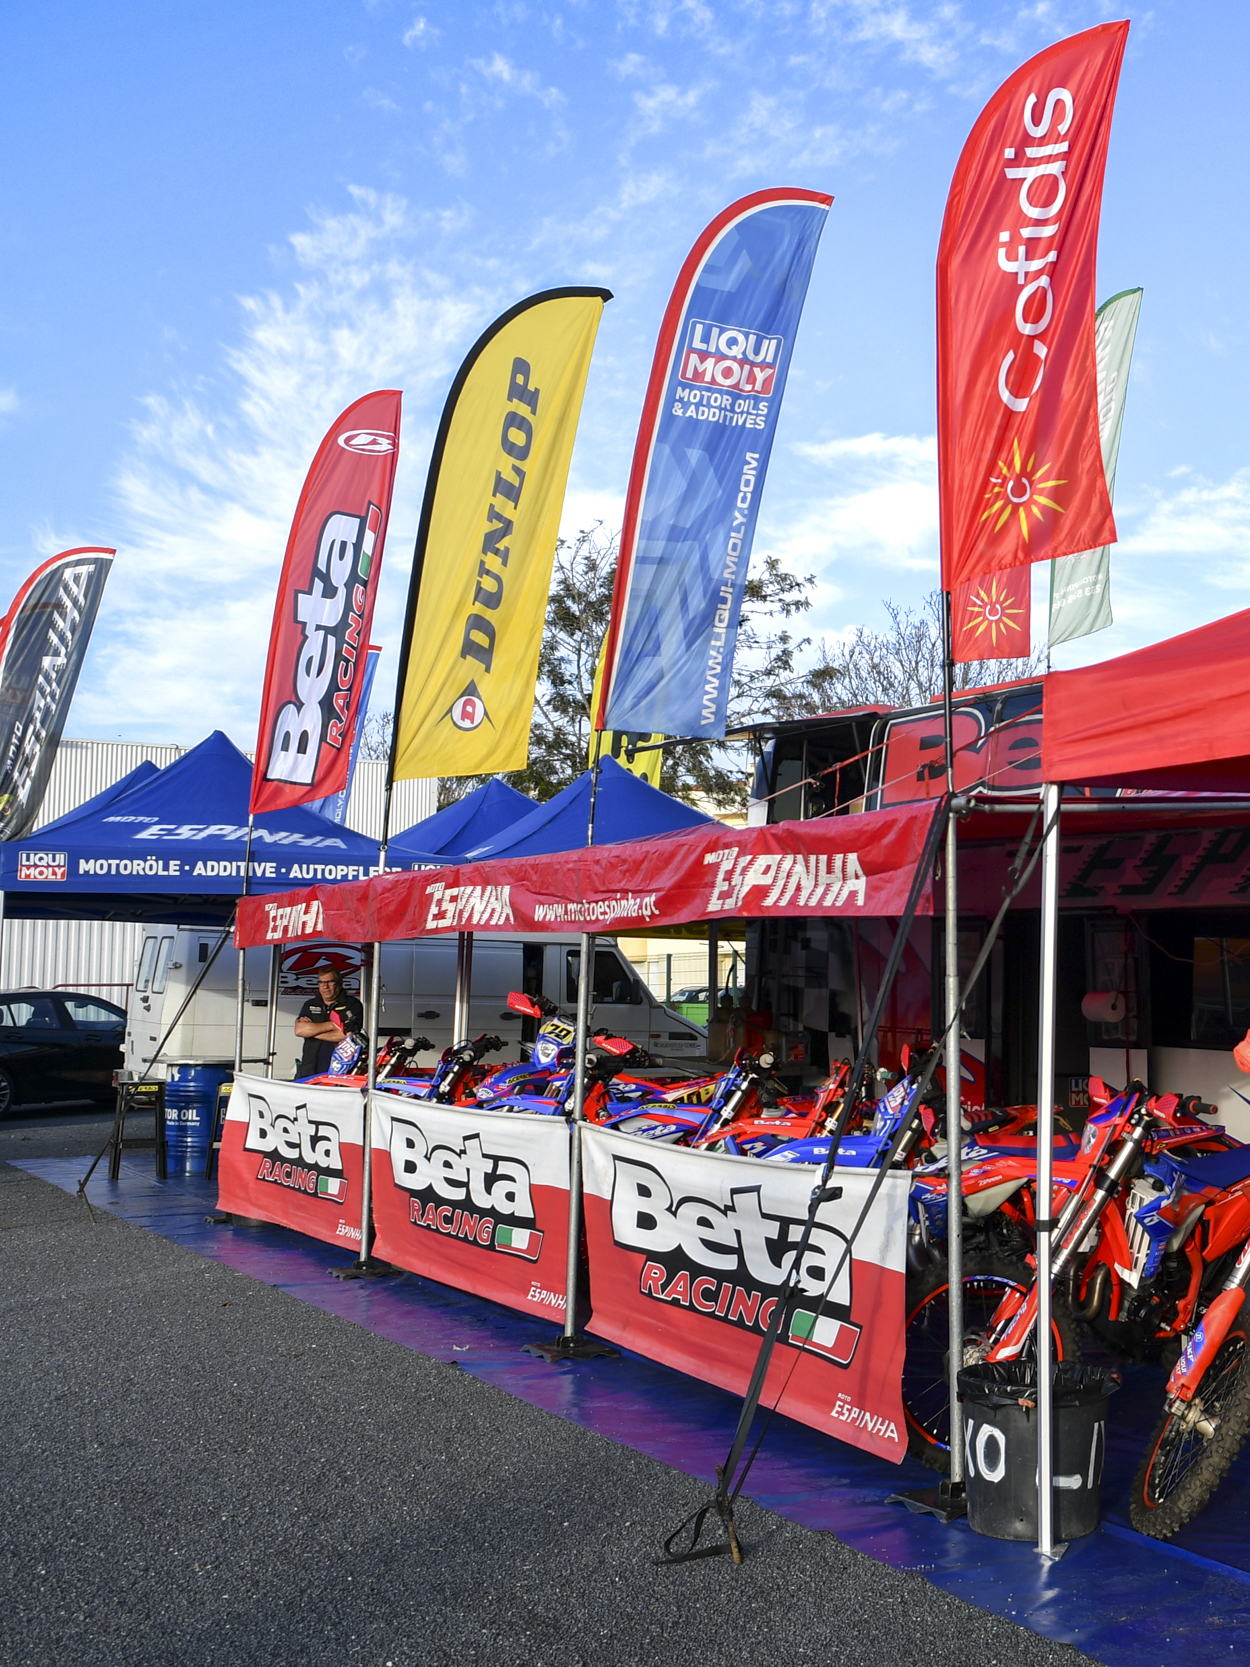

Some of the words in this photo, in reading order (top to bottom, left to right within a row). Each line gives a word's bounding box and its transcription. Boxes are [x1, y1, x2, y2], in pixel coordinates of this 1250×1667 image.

[998, 87, 1074, 412] Cofidis
[692, 324, 779, 363] LIQUI
[686, 352, 773, 394] MOLY
[671, 402, 685, 416] &
[685, 404, 765, 429] ADDITIVES
[675, 387, 733, 410] MOTOR
[735, 396, 768, 415] OILS
[461, 356, 541, 674] DUNLOP
[700, 452, 759, 726] WWW.LIQUI-MOLY.COM
[266, 513, 362, 784] Beta
[327, 585, 366, 748] RACING
[13, 564, 96, 809] ESPINHA
[134, 824, 347, 849] ESPINHA
[703, 847, 739, 865] MOTO
[20, 866, 67, 880] MOLY
[22, 852, 65, 867] LIQUI
[79, 856, 180, 877] MOTORÖLE
[193, 860, 276, 878] ADDITIVE
[706, 853, 866, 912] ESPINHA
[180, 1109, 201, 1120] OIL
[251, 1097, 341, 1169] Beta
[753, 1119, 792, 1127] Beta
[393, 1119, 535, 1219] Beta
[813, 1148, 856, 1156] Bta
[258, 1159, 317, 1194] RACING
[409, 1198, 496, 1246] RACING
[613, 1157, 851, 1306] Beta
[527, 1286, 567, 1310] ESPINH
[641, 1260, 784, 1334] RACING
[830, 1400, 899, 1443] ESPINHA
